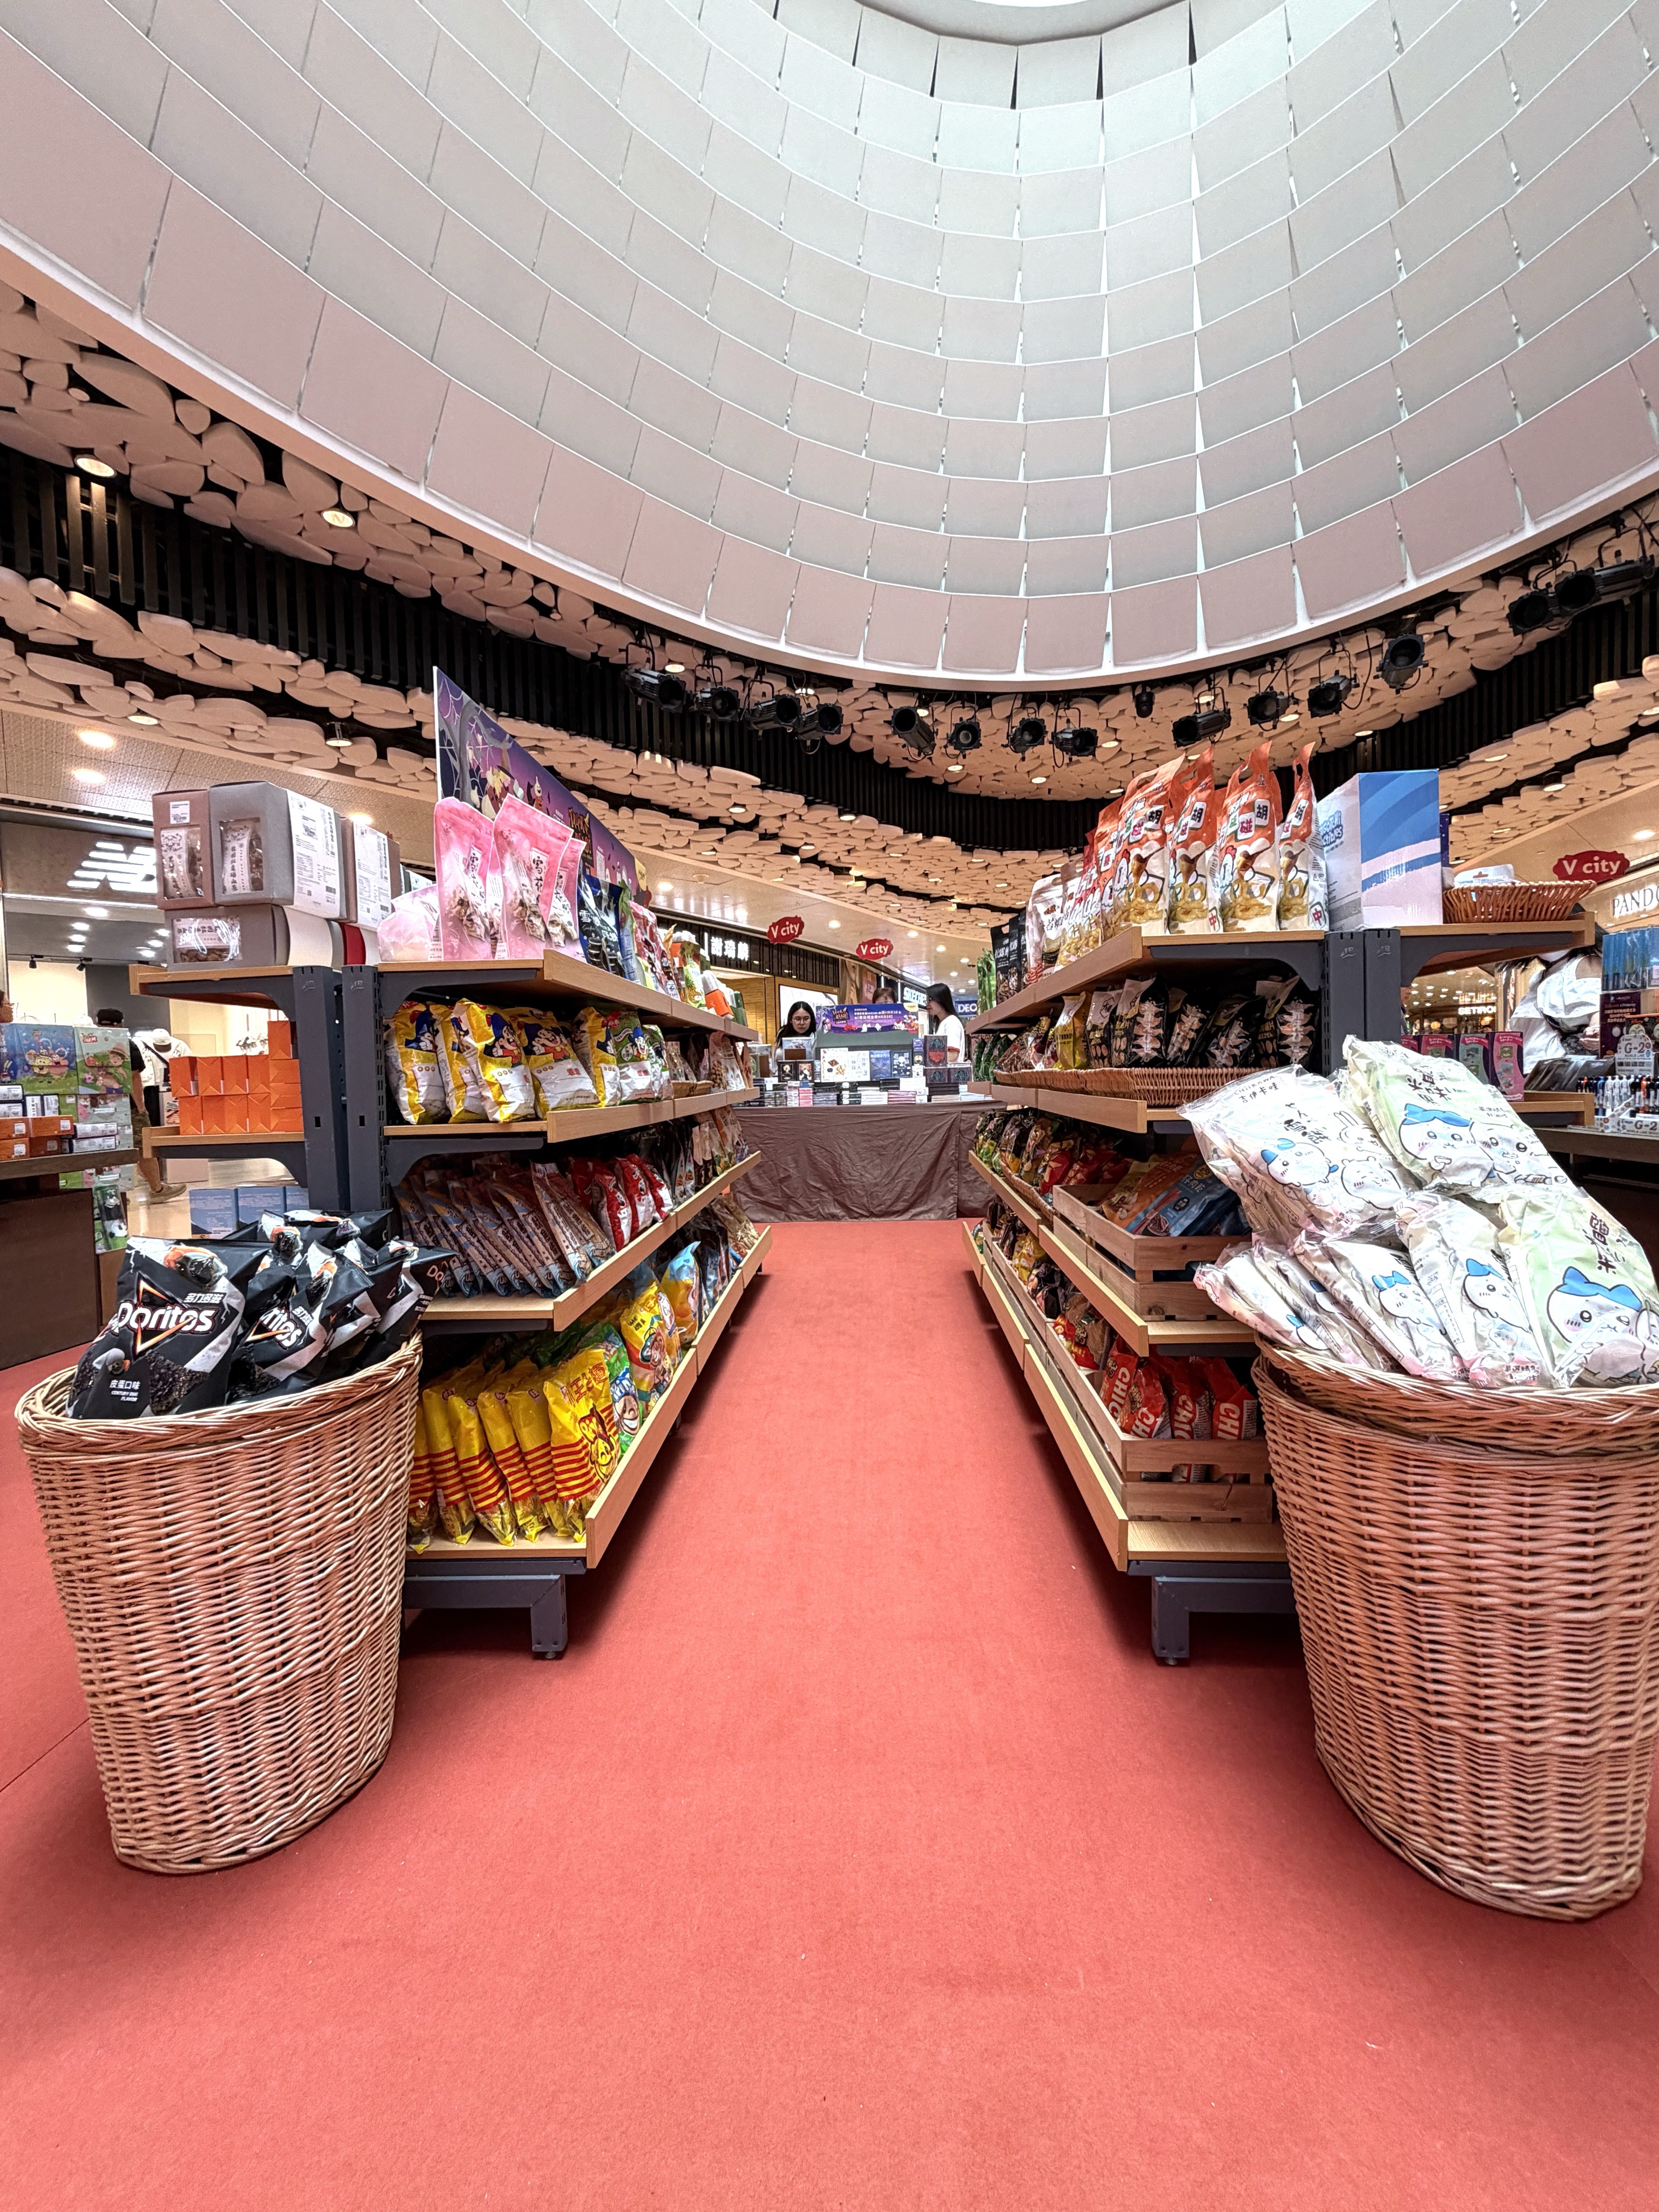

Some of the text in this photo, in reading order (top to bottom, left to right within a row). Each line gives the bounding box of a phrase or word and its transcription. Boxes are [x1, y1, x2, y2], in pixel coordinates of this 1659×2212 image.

[1190, 807, 1204, 823] 胡
[1239, 818, 1253, 834] 碰
[1256, 804, 1269, 820] 胡
[1294, 804, 1306, 821] 胡
[1562, 855, 1621, 875] V city
[1312, 908, 1323, 926] 中
[771, 921, 800, 939] V city
[860, 942, 889, 955] V city
[1624, 1042, 1645, 1054] G-2
[1238, 1082, 1279, 1103] 吉伊卡哇
[1634, 1120, 1658, 1131] G-2
[184, 1292, 224, 1304] 多力多滋
[110, 1301, 217, 1332] Doritos
[109, 1379, 141, 1390] 皮蛋口味
[1131, 1407, 1155, 1439] CH
